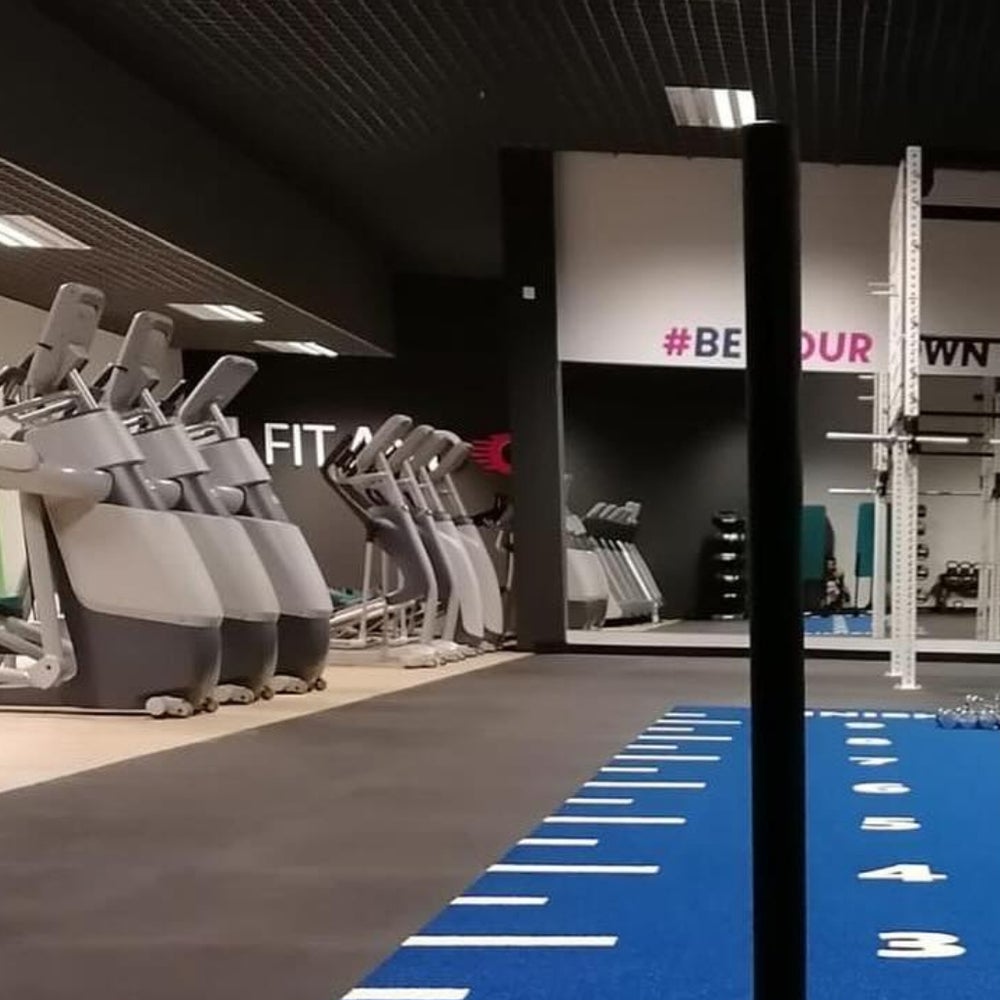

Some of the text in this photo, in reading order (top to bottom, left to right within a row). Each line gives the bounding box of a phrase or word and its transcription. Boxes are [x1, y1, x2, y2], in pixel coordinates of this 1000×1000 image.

[664, 327, 742, 358] #BE
[800, 331, 874, 363] OUR
[264, 422, 336, 467] FIT
[860, 816, 921, 831] 5
[858, 863, 947, 882] 4
[876, 931, 966, 958] 3
